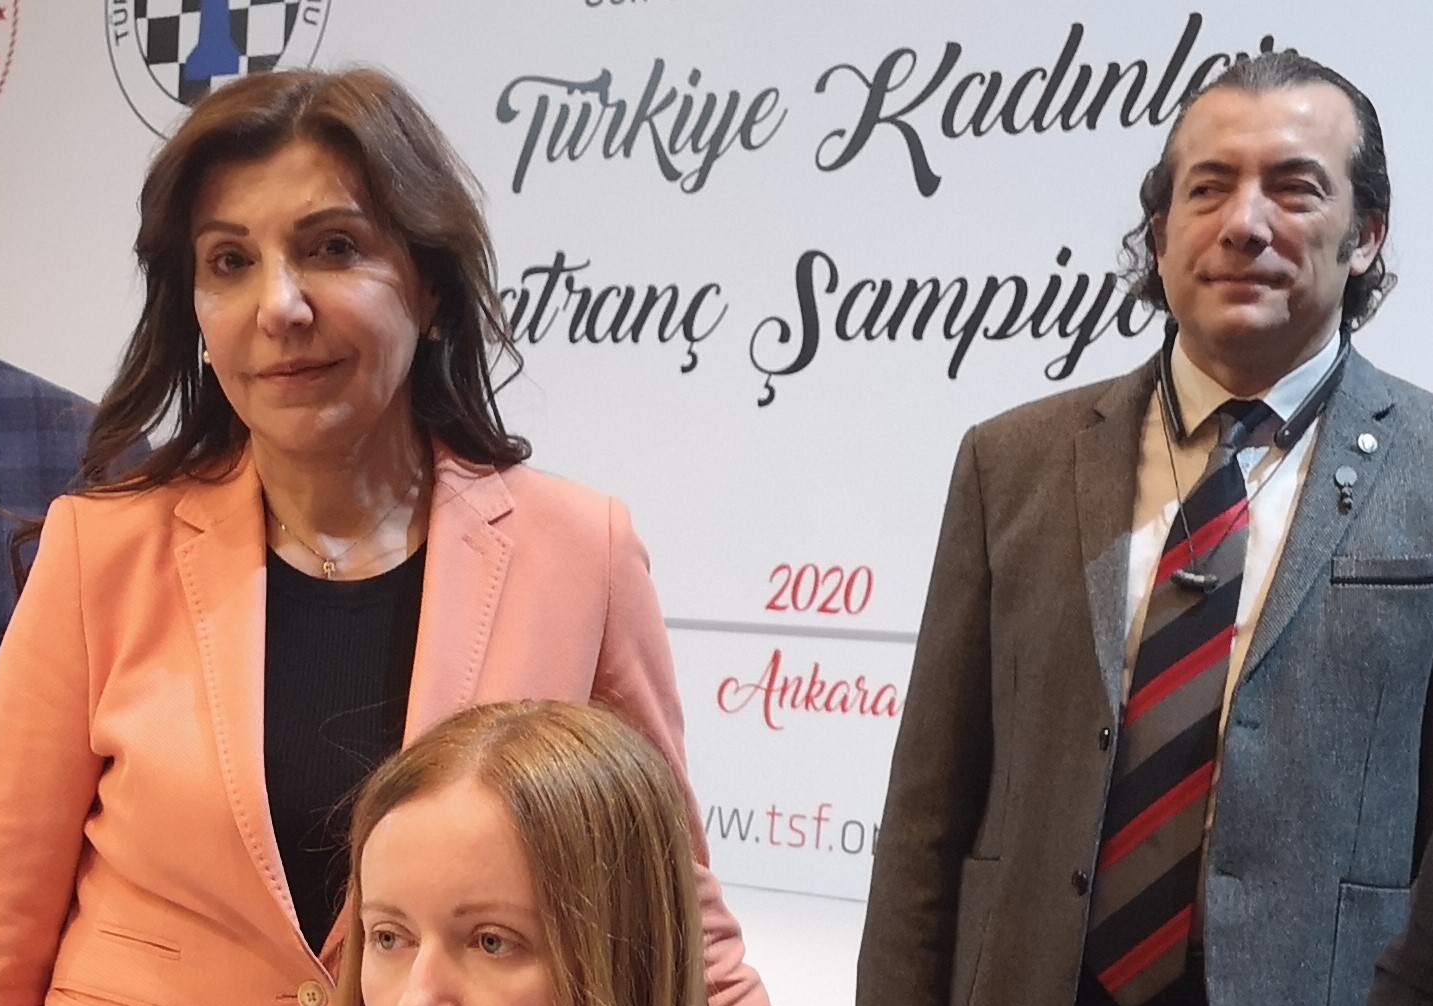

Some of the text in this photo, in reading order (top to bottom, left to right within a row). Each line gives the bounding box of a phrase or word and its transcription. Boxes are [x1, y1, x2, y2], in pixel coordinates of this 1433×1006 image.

[496, 57, 788, 194] Türkiye
[498, 249, 728, 374] atranç
[765, 562, 874, 616] 2020
[717, 648, 906, 731] Ankara
